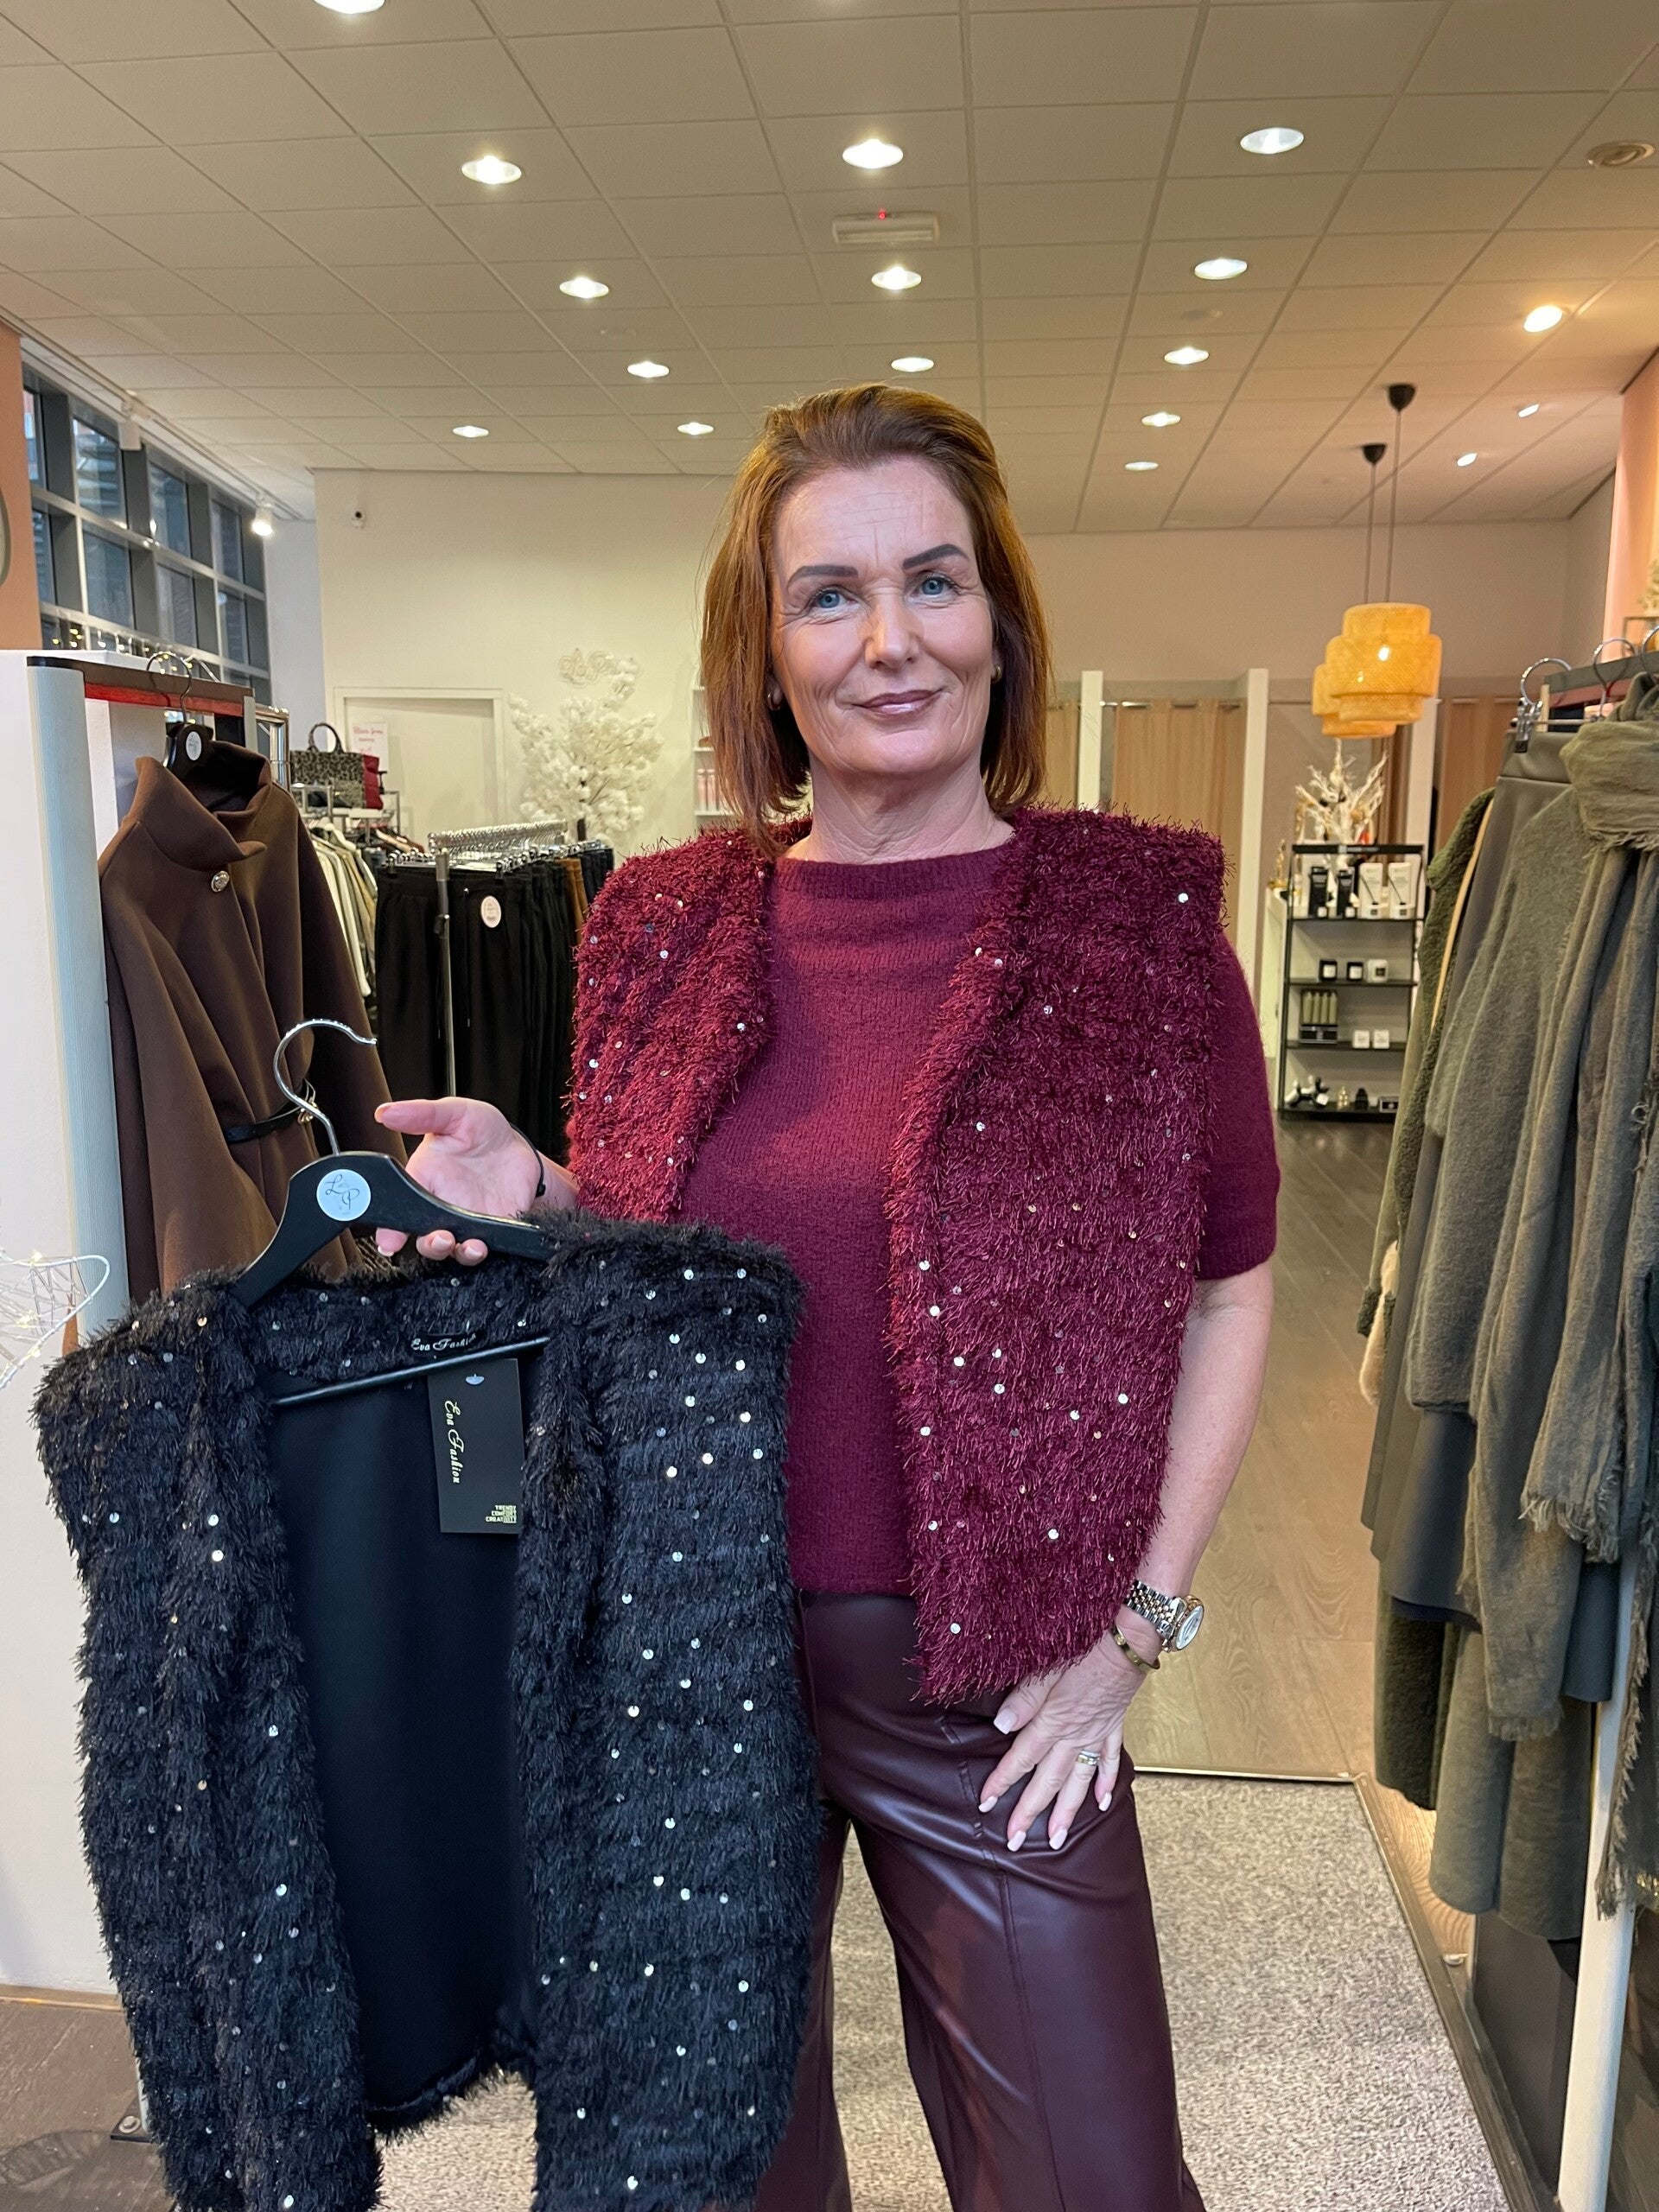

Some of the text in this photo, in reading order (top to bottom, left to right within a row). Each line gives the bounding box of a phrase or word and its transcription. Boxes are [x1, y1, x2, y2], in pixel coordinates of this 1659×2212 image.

[410, 1338, 430, 1351] Eva
[444, 1400, 465, 1484] Eva Fashion
